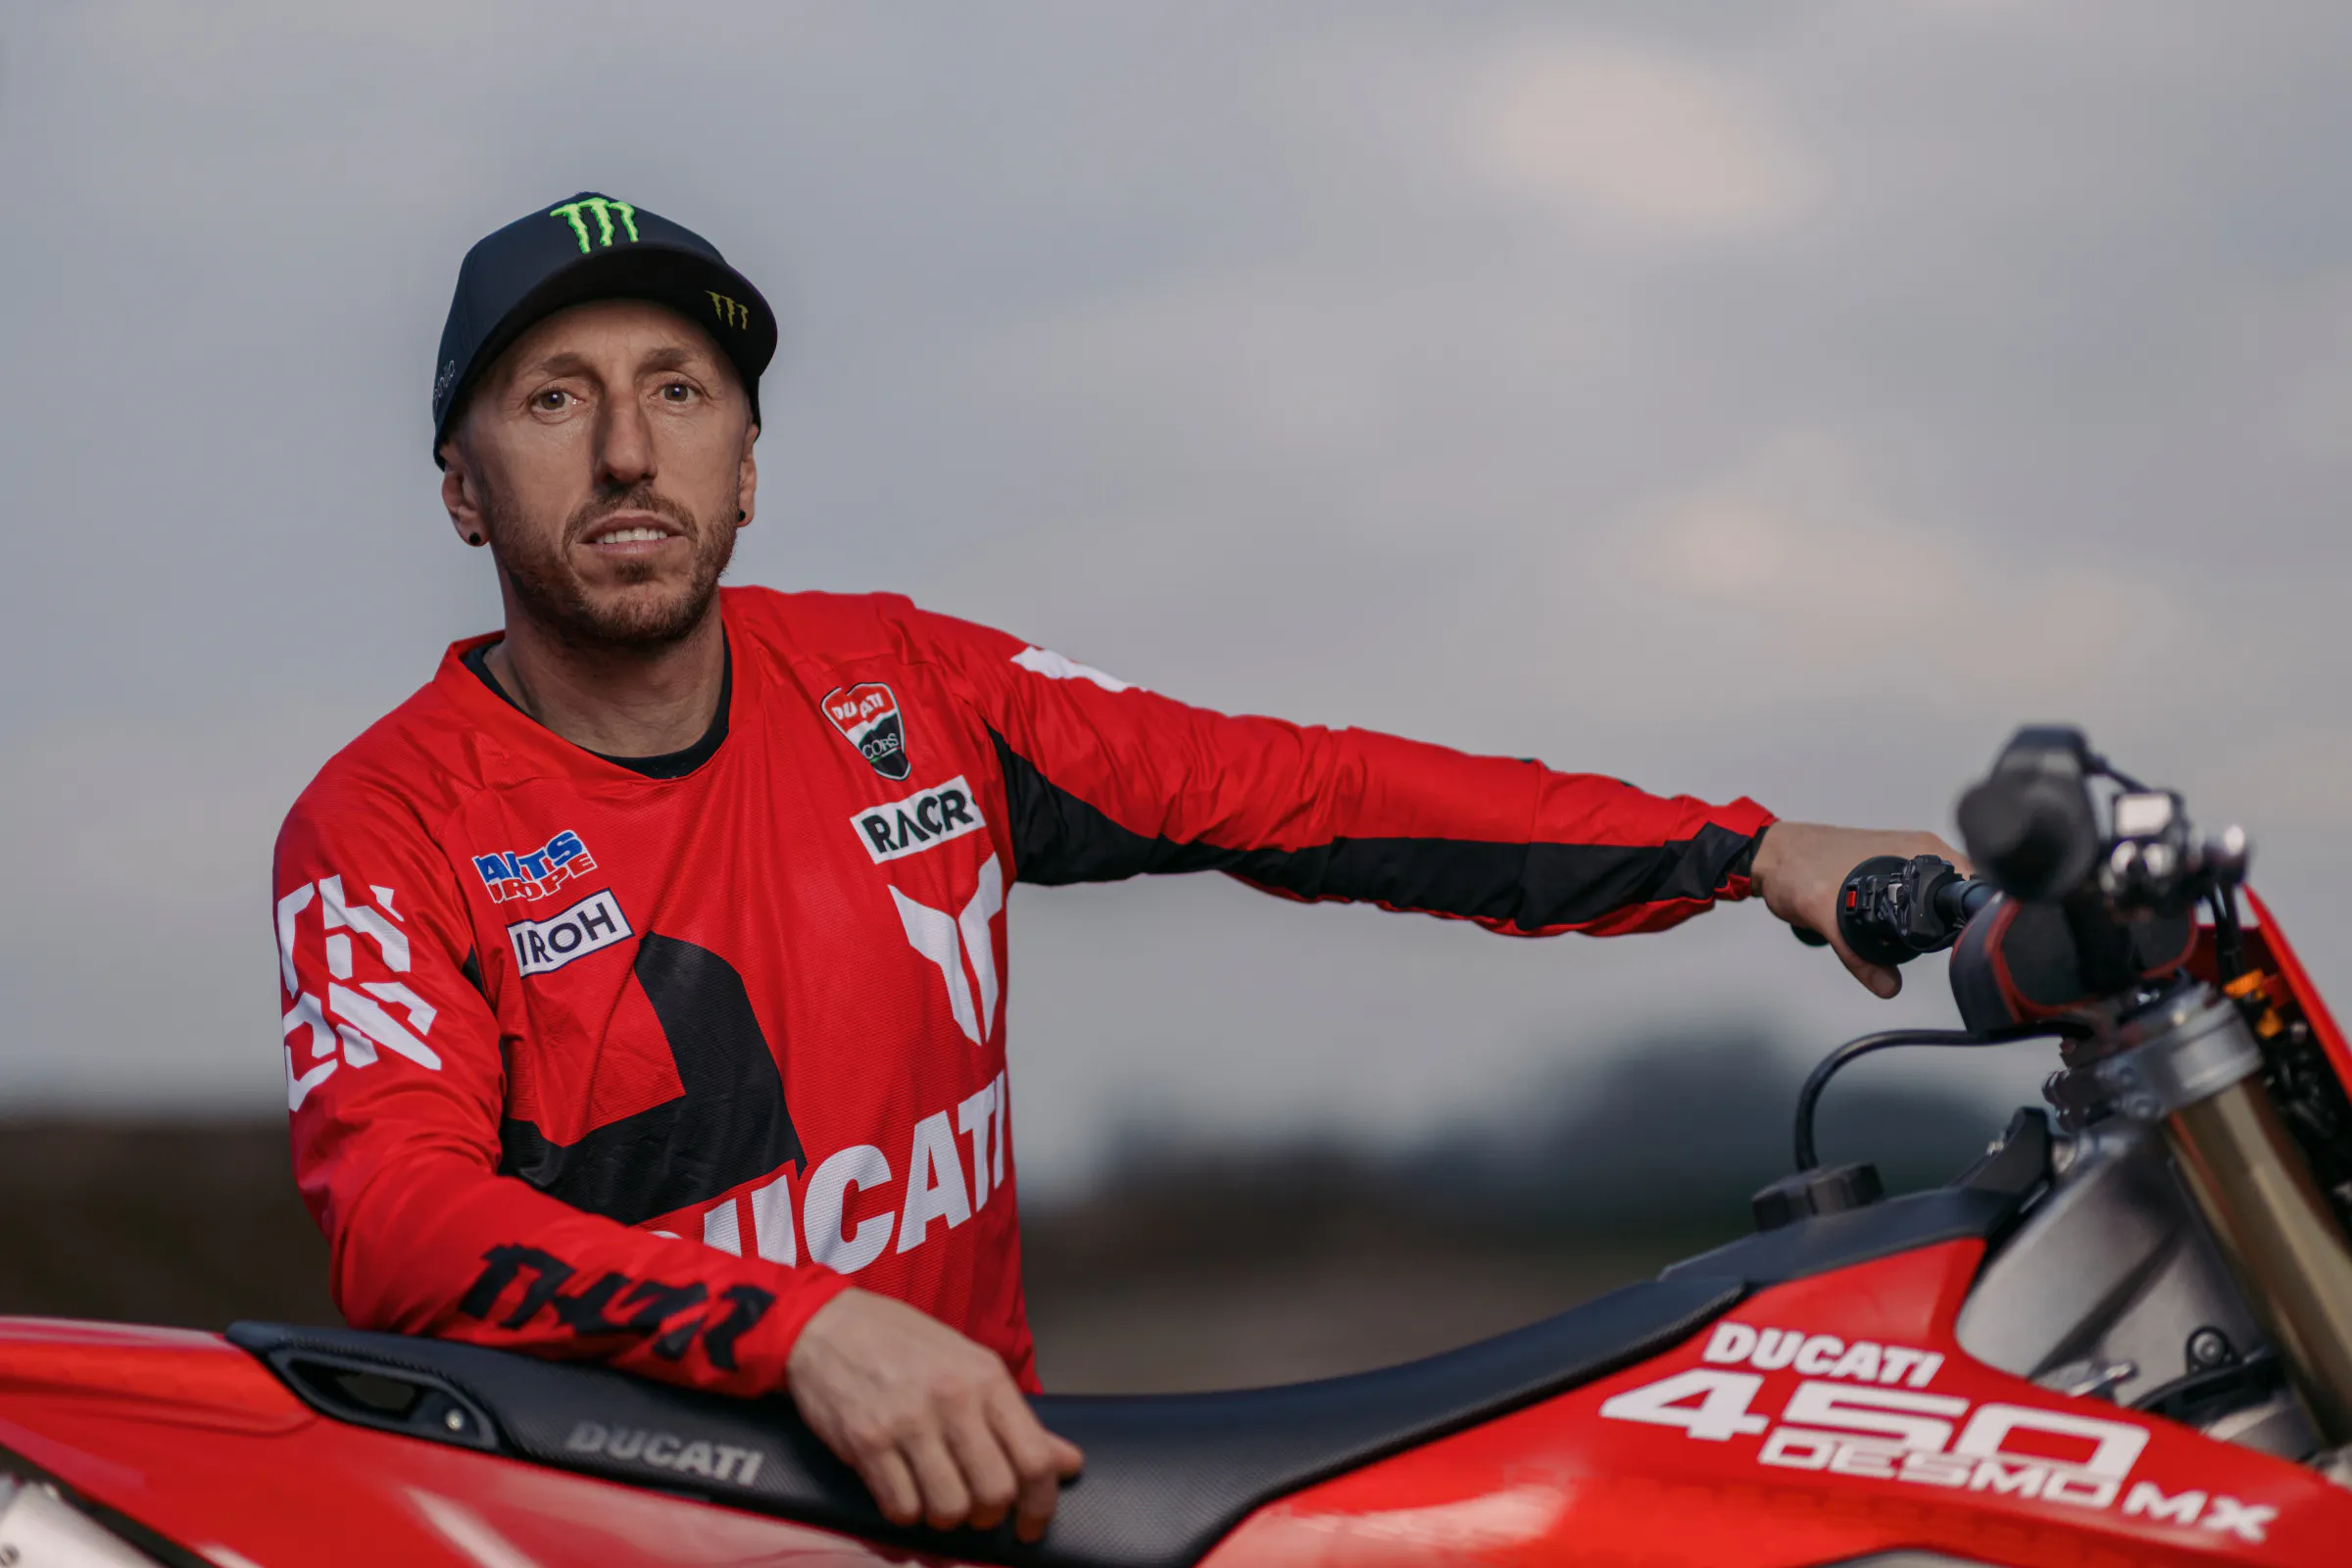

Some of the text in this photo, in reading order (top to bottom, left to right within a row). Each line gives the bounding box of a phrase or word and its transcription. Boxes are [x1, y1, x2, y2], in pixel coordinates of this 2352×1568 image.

[831, 692, 884, 720] DUATI
[647, 1070, 1005, 1275] UCATI
[1702, 1321, 1945, 1388] DUCATI
[564, 1421, 765, 1487] DUCATI
[1598, 1367, 2150, 1482] 450
[1757, 1424, 2278, 1542] DESMO MX
